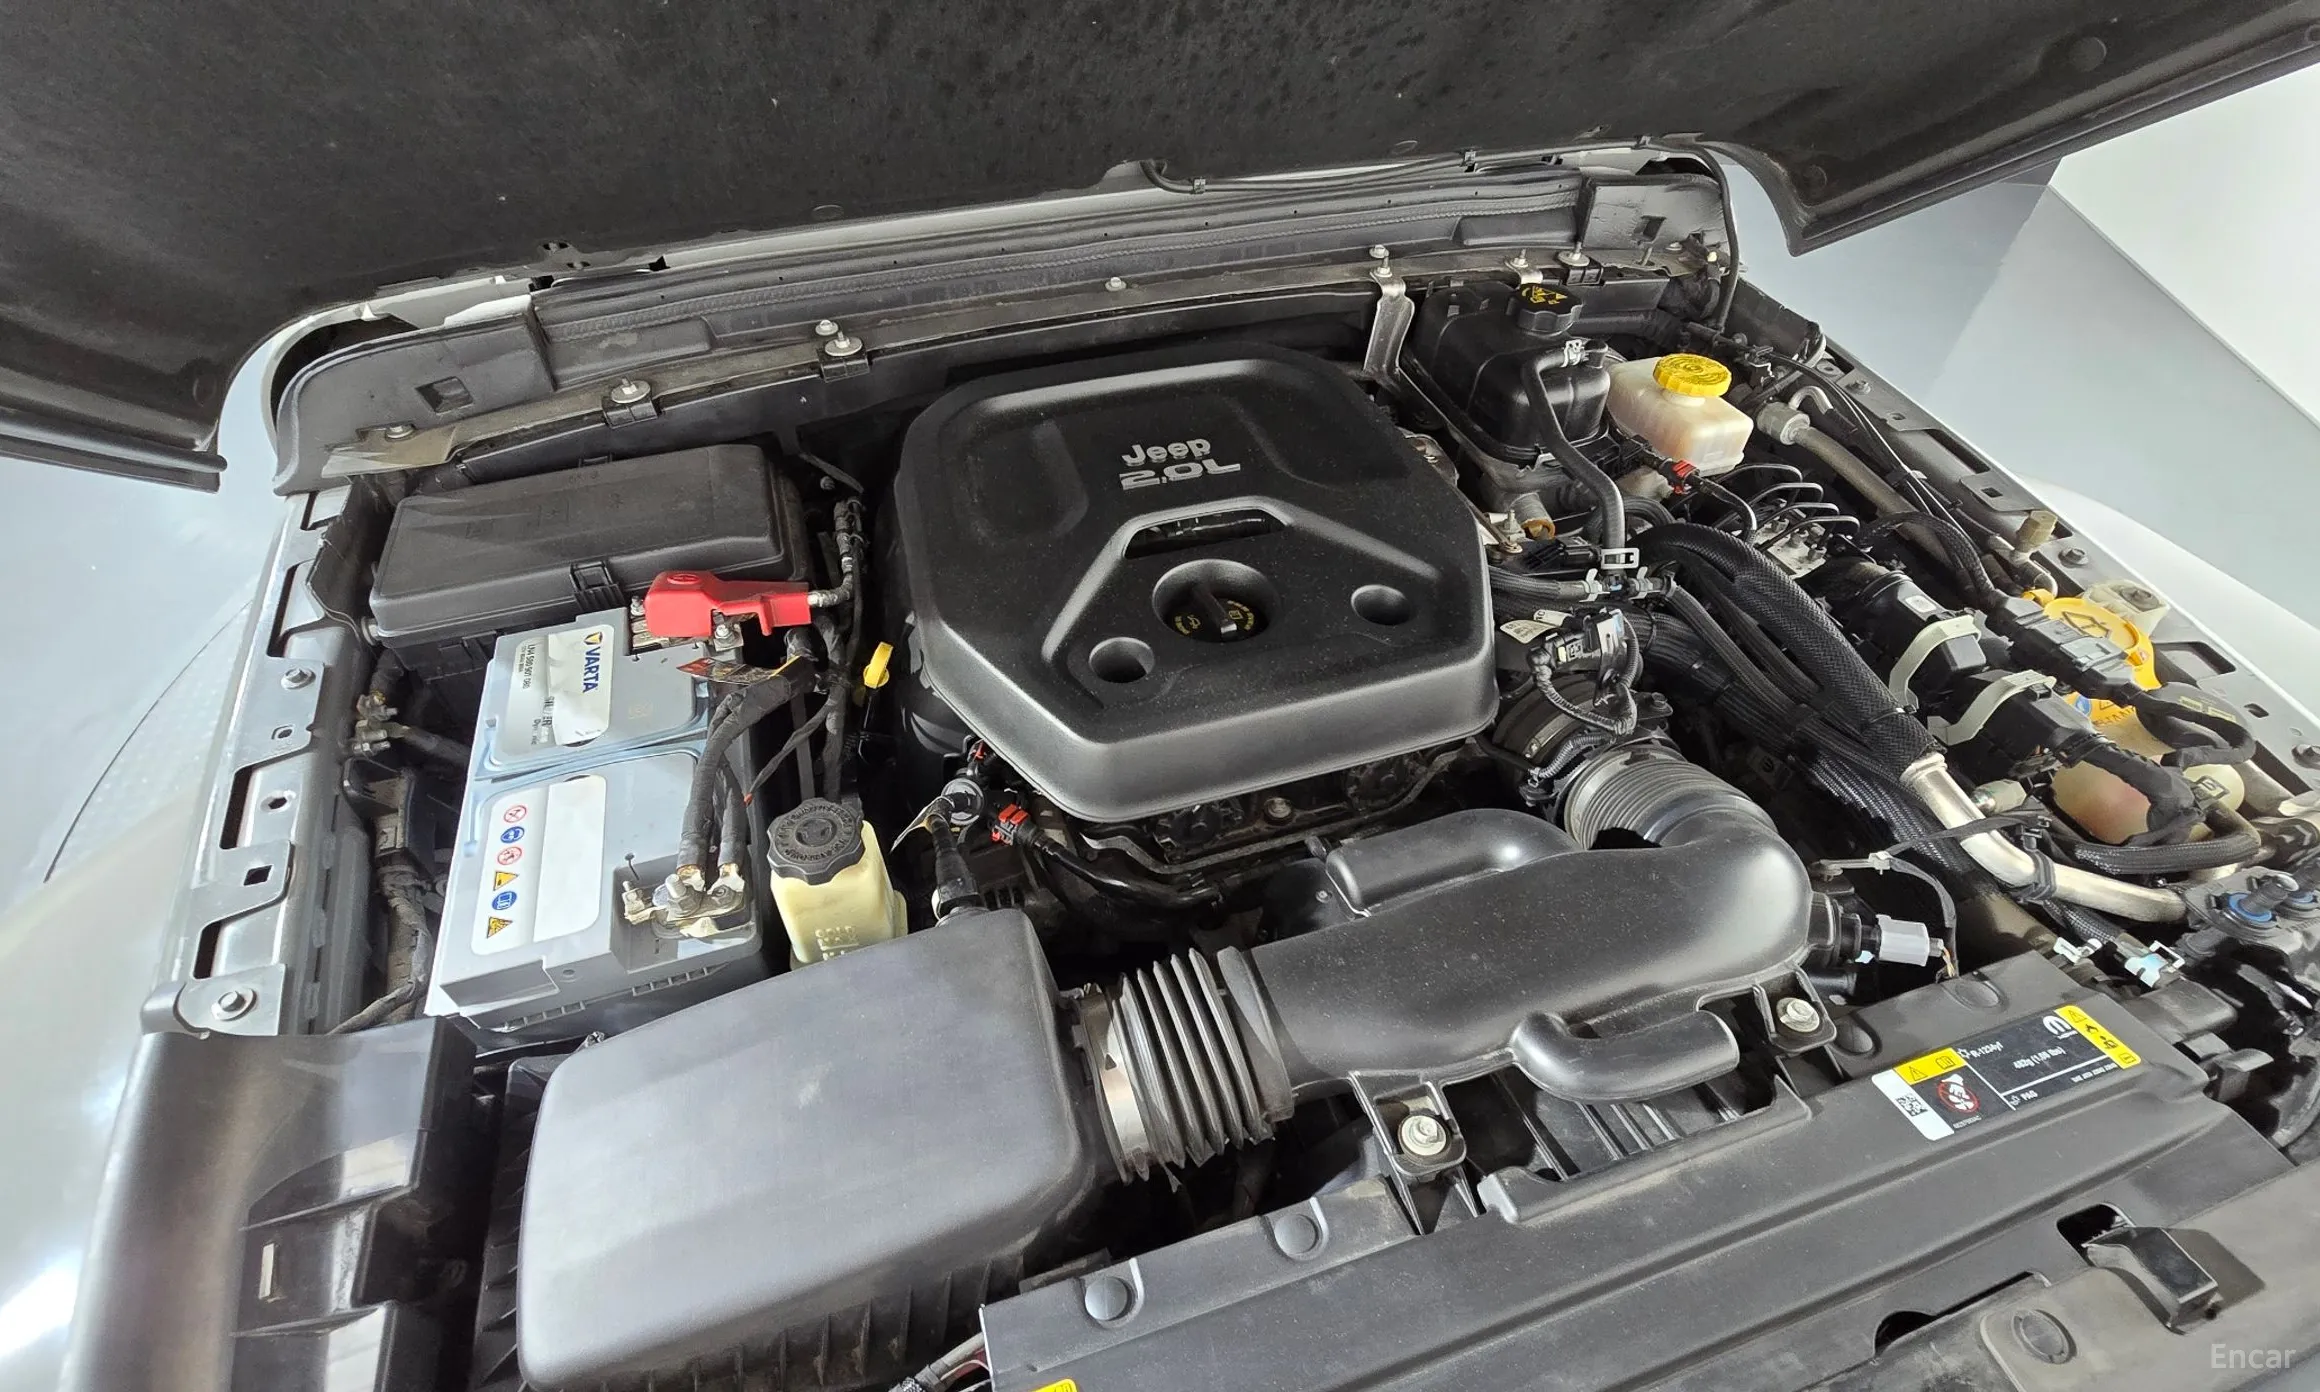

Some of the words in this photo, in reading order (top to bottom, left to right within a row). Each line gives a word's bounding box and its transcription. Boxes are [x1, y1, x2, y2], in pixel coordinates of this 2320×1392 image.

[1121, 437, 1212, 466] Jeep
[1119, 459, 1240, 490] 2.0L
[582, 647, 601, 693] VARTA
